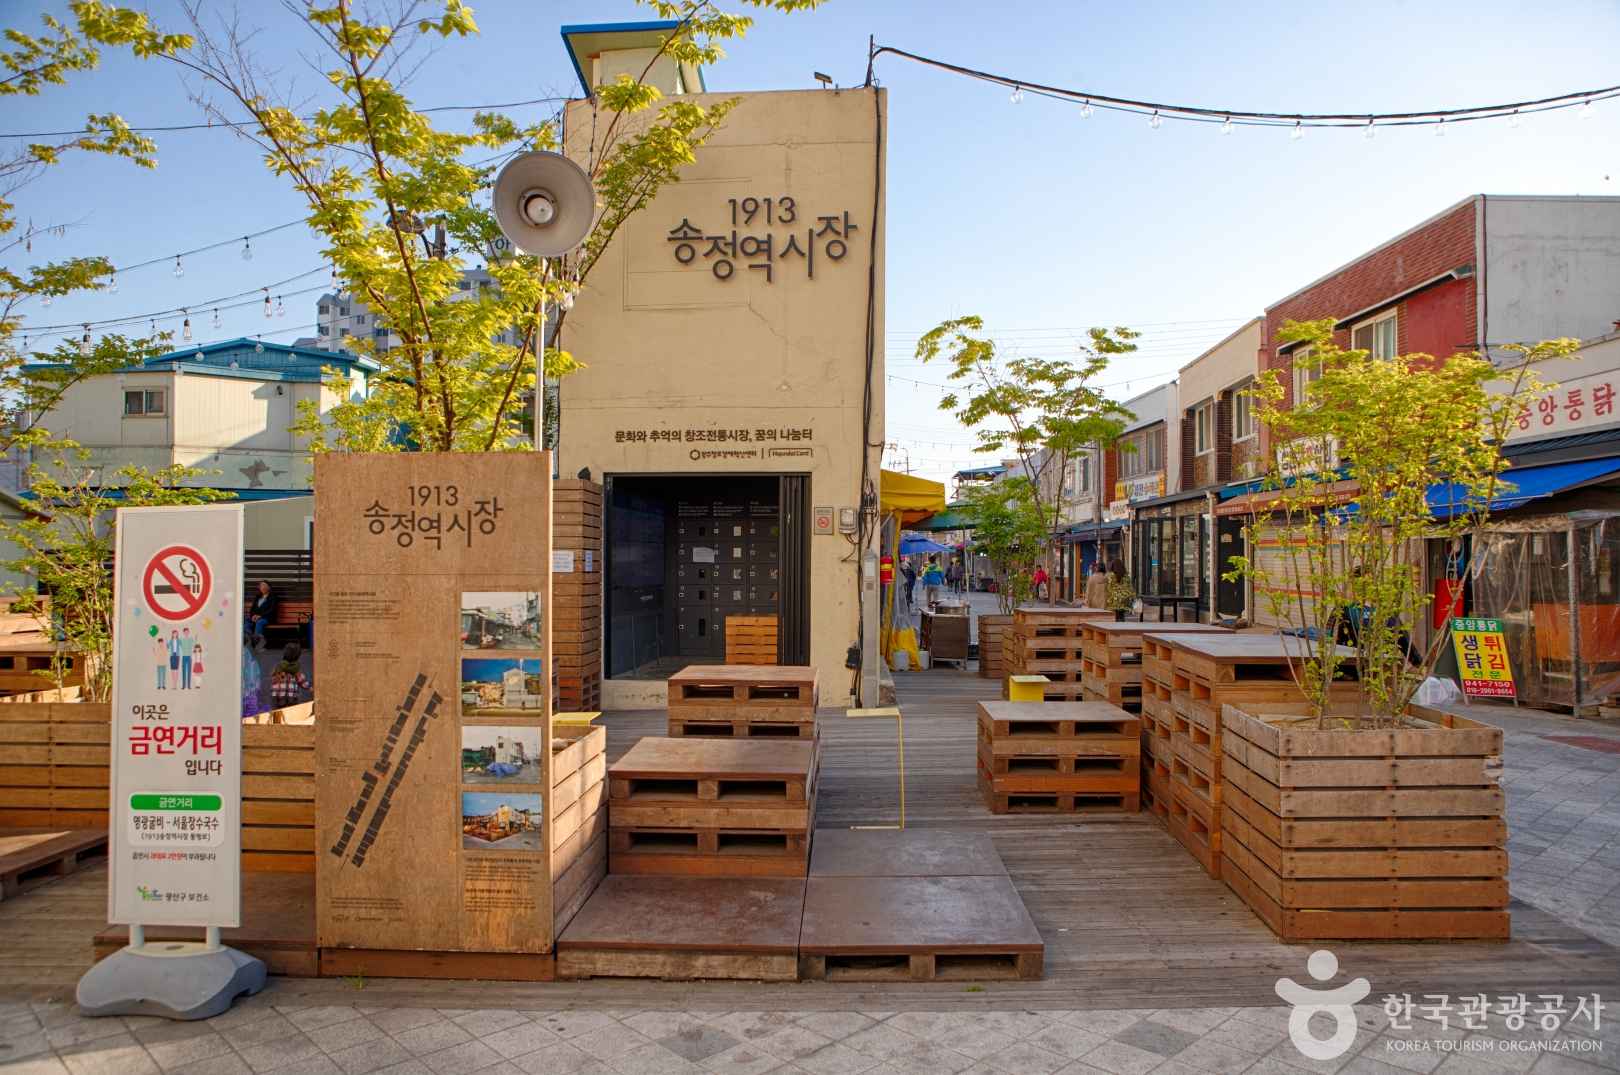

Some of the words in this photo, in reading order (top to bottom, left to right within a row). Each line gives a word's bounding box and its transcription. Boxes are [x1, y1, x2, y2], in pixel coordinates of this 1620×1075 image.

[728, 196, 796, 226] 1913
[667, 210, 858, 283] 송정역시장
[615, 431, 647, 443] 문화와
[650, 430, 682, 442] 추억의
[684, 429, 752, 442] 창조전통시장,
[755, 429, 777, 441] 꿈의
[780, 428, 813, 441] 나눔터
[407, 485, 459, 507] 1913
[363, 496, 504, 550] 송정역시장
[132, 704, 170, 721] 이곳은
[129, 726, 223, 755] 금연거리
[185, 759, 222, 775] 입니다
[159, 797, 193, 809] 금연거리
[172, 816, 219, 831] 서울장수국수
